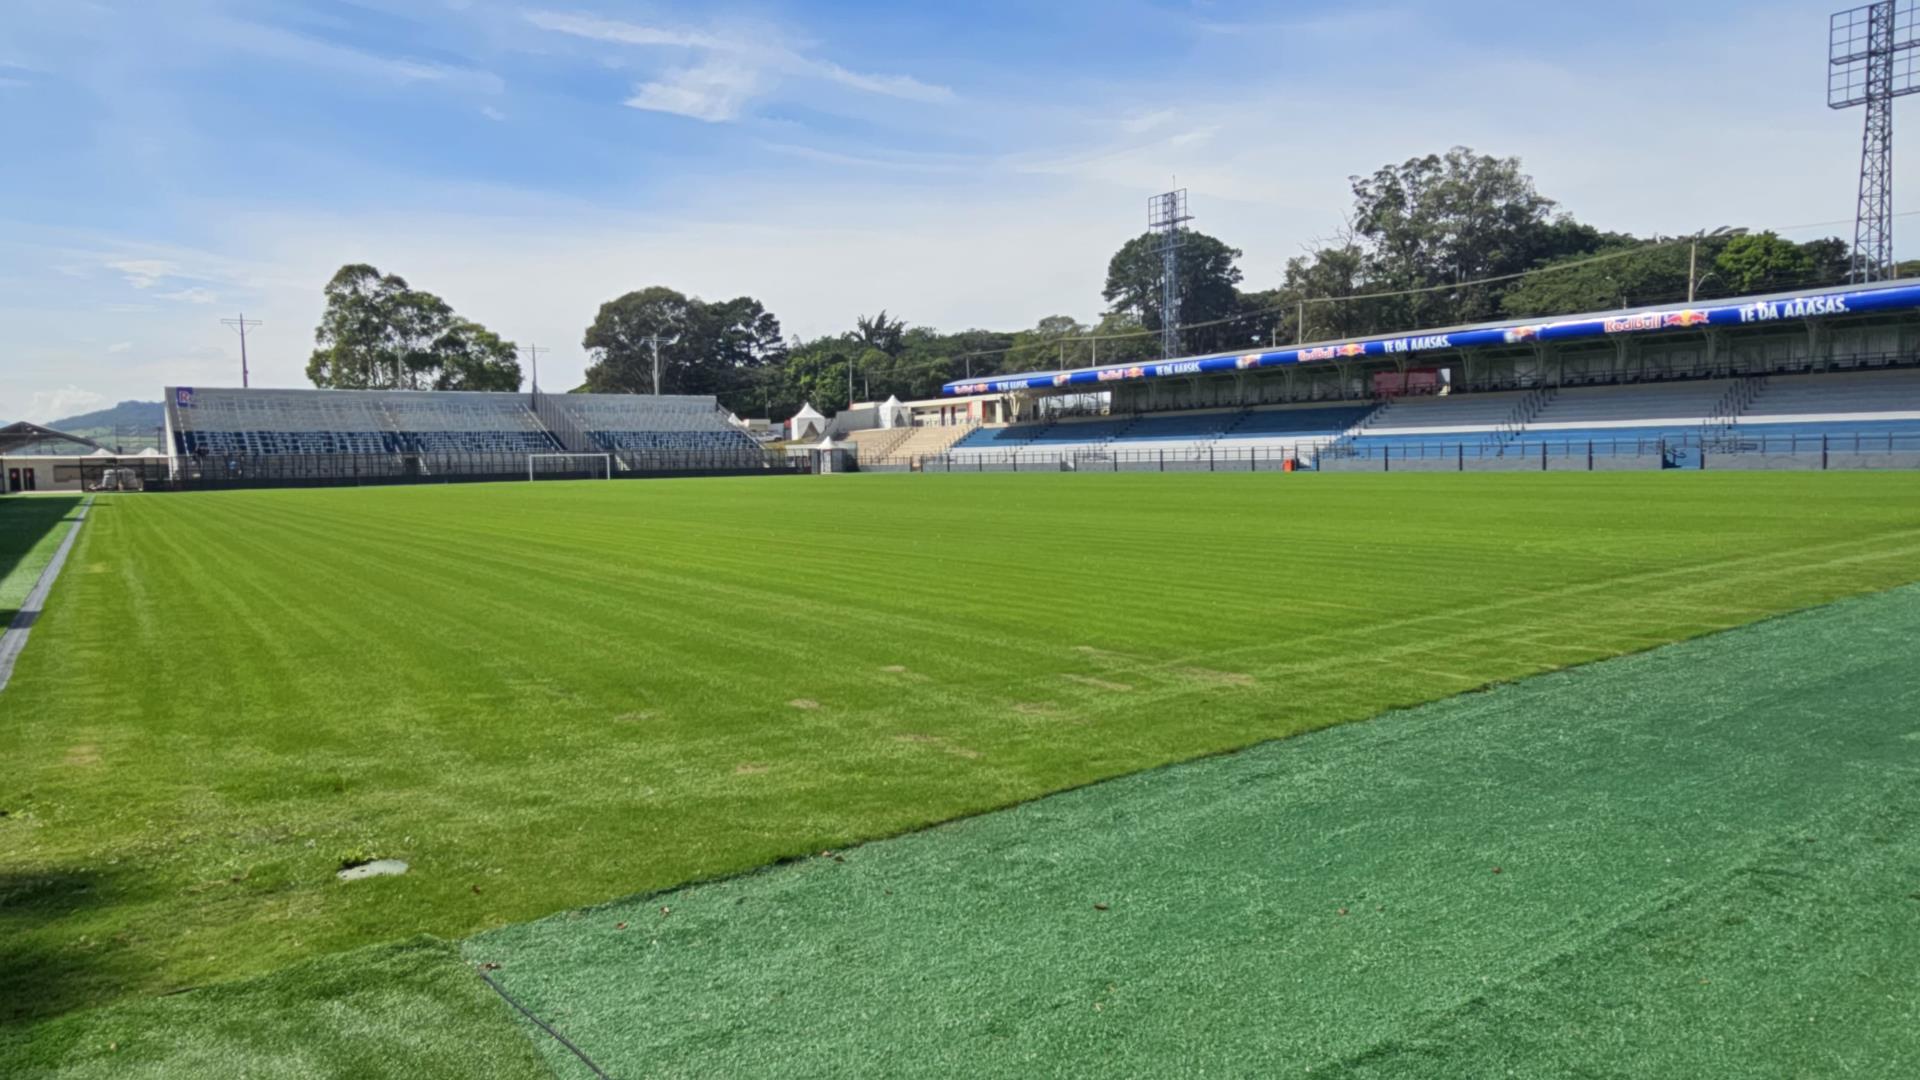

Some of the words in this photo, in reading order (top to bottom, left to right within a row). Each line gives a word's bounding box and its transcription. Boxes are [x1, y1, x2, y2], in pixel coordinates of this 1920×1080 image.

[1739, 305, 1755, 322] TE
[1604, 316, 1632, 333] Red
[1632, 313, 1661, 331] Bull
[1384, 340, 1394, 352] TE
